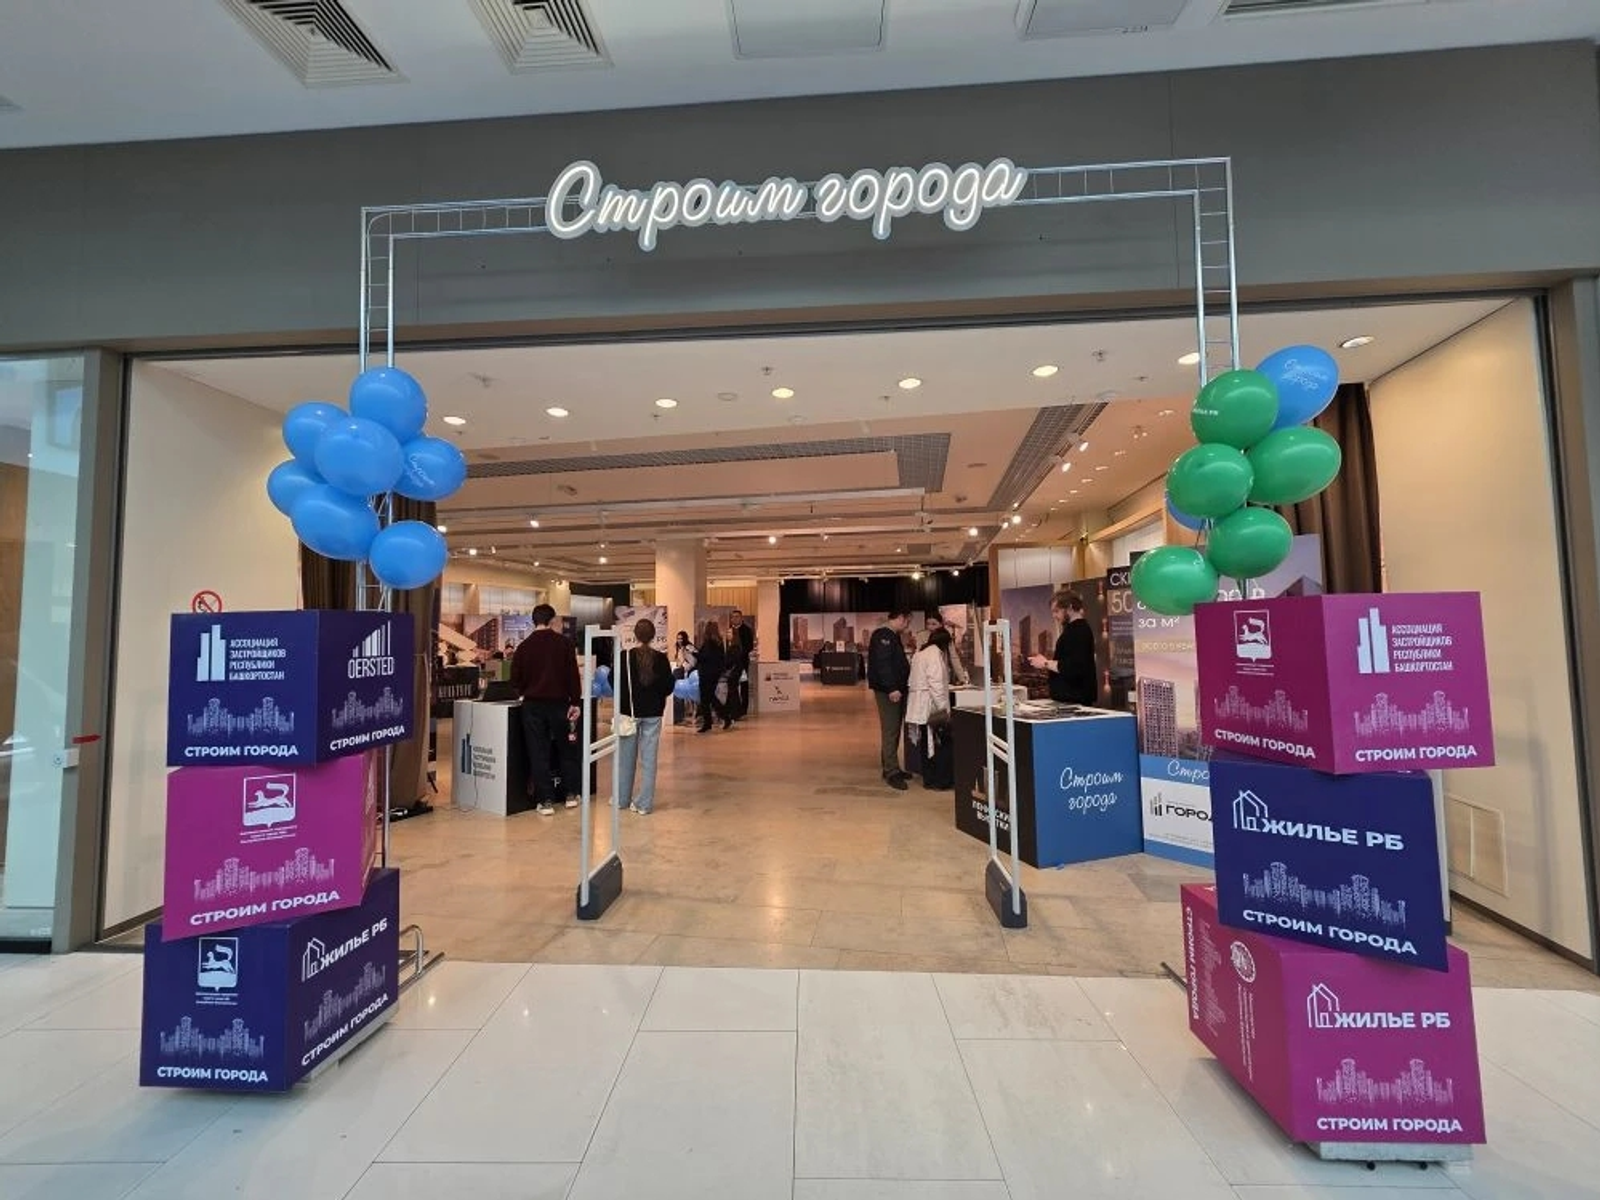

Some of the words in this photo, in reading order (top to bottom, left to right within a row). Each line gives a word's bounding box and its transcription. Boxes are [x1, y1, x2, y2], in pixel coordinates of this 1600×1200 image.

[546, 160, 807, 251] Строим
[814, 158, 1025, 240] города
[347, 657, 395, 679] OERSTED
[329, 734, 370, 751] СТРОИМ
[371, 726, 405, 741] ГОРОДА
[1214, 728, 1259, 747] СТРОИМ
[1262, 738, 1316, 759] ГОРОДА
[184, 747, 240, 758] СТРОИМ
[243, 745, 299, 757] ГОРОДА
[1355, 747, 1416, 762] СТРОИМ
[1419, 745, 1478, 758] ГОРОДА
[1060, 767, 1124, 792] Строим
[1068, 792, 1118, 815] города
[1166, 804, 1213, 822] ГОРО
[1261, 818, 1358, 845] ЖИЛЬЕ
[1366, 831, 1405, 850] РБ
[190, 902, 267, 926] СТРОИМ
[271, 889, 340, 912] ГОРОДА
[320, 928, 370, 970] ЖИЛЬЕ
[371, 918, 389, 937] РБ
[1242, 909, 1323, 936] СТРОИМ
[1329, 926, 1418, 955] ГОРОДА
[301, 1024, 349, 1067] СТРОИМ
[350, 993, 389, 1030] ГОРОДА
[1333, 1011, 1416, 1029] ЖИЛЬЕ
[1421, 1011, 1450, 1028] РБ
[157, 1066, 211, 1080] СТРОИМ
[214, 1067, 269, 1083] ГОРОДА
[1317, 1118, 1388, 1132] СТРОИМ
[1393, 1118, 1463, 1134] ГОРОДА
